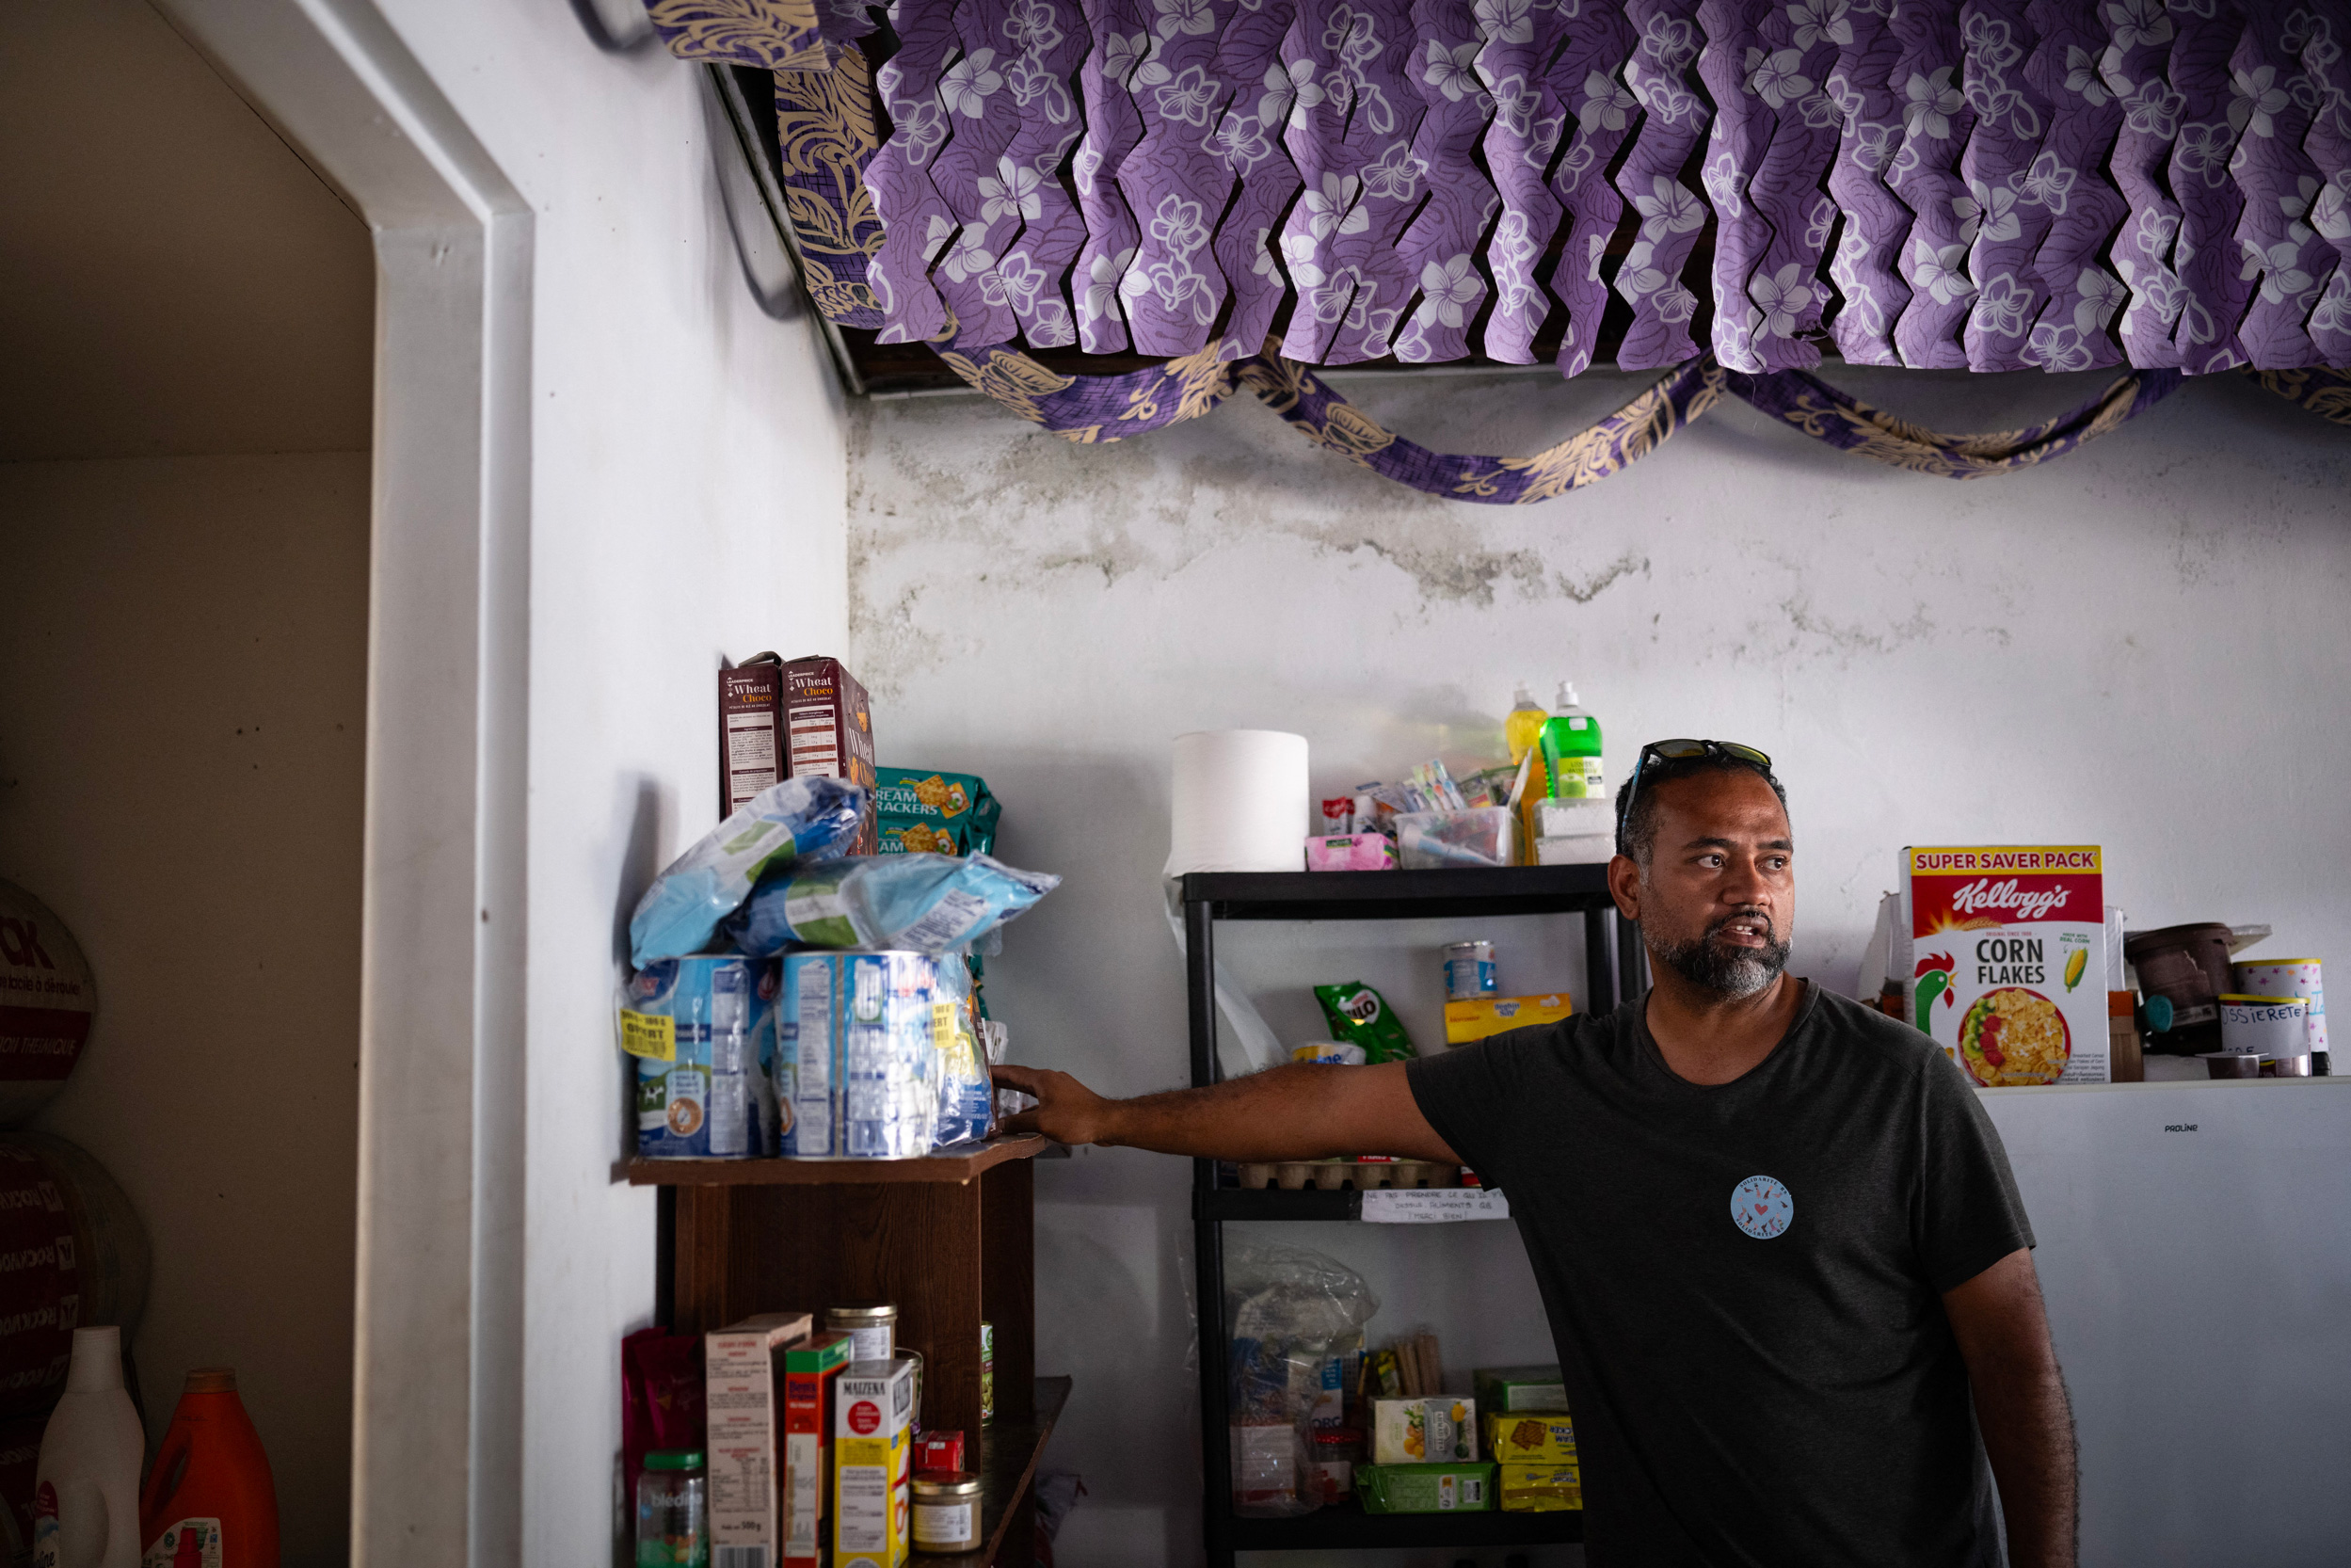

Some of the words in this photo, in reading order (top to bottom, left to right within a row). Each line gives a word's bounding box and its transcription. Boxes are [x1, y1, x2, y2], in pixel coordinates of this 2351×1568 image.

[734, 683, 772, 695] Wheat
[795, 677, 832, 688] Wheat
[804, 687, 834, 696] Choco
[743, 694, 772, 703] Choco
[848, 727, 874, 767] Wheat
[875, 791, 918, 803] REAM
[876, 801, 938, 816] RACKERS
[1915, 853, 1976, 871] SUPER
[1980, 853, 2041, 870] SAVER
[2044, 852, 2095, 869] PACK
[1952, 877, 2069, 920] Kellogg's
[2074, 936, 2090, 945] CORN
[1976, 938, 2043, 964] CORN
[1977, 965, 2046, 985] FLAKES
[934, 1016, 948, 1028] ERT
[1739, 1176, 1778, 1189] SOLIDARITE
[1735, 1218, 1774, 1238] SOLIDARITE
[843, 1382, 887, 1396] MAIZENA
[1549, 1425, 1574, 1434] CKER
